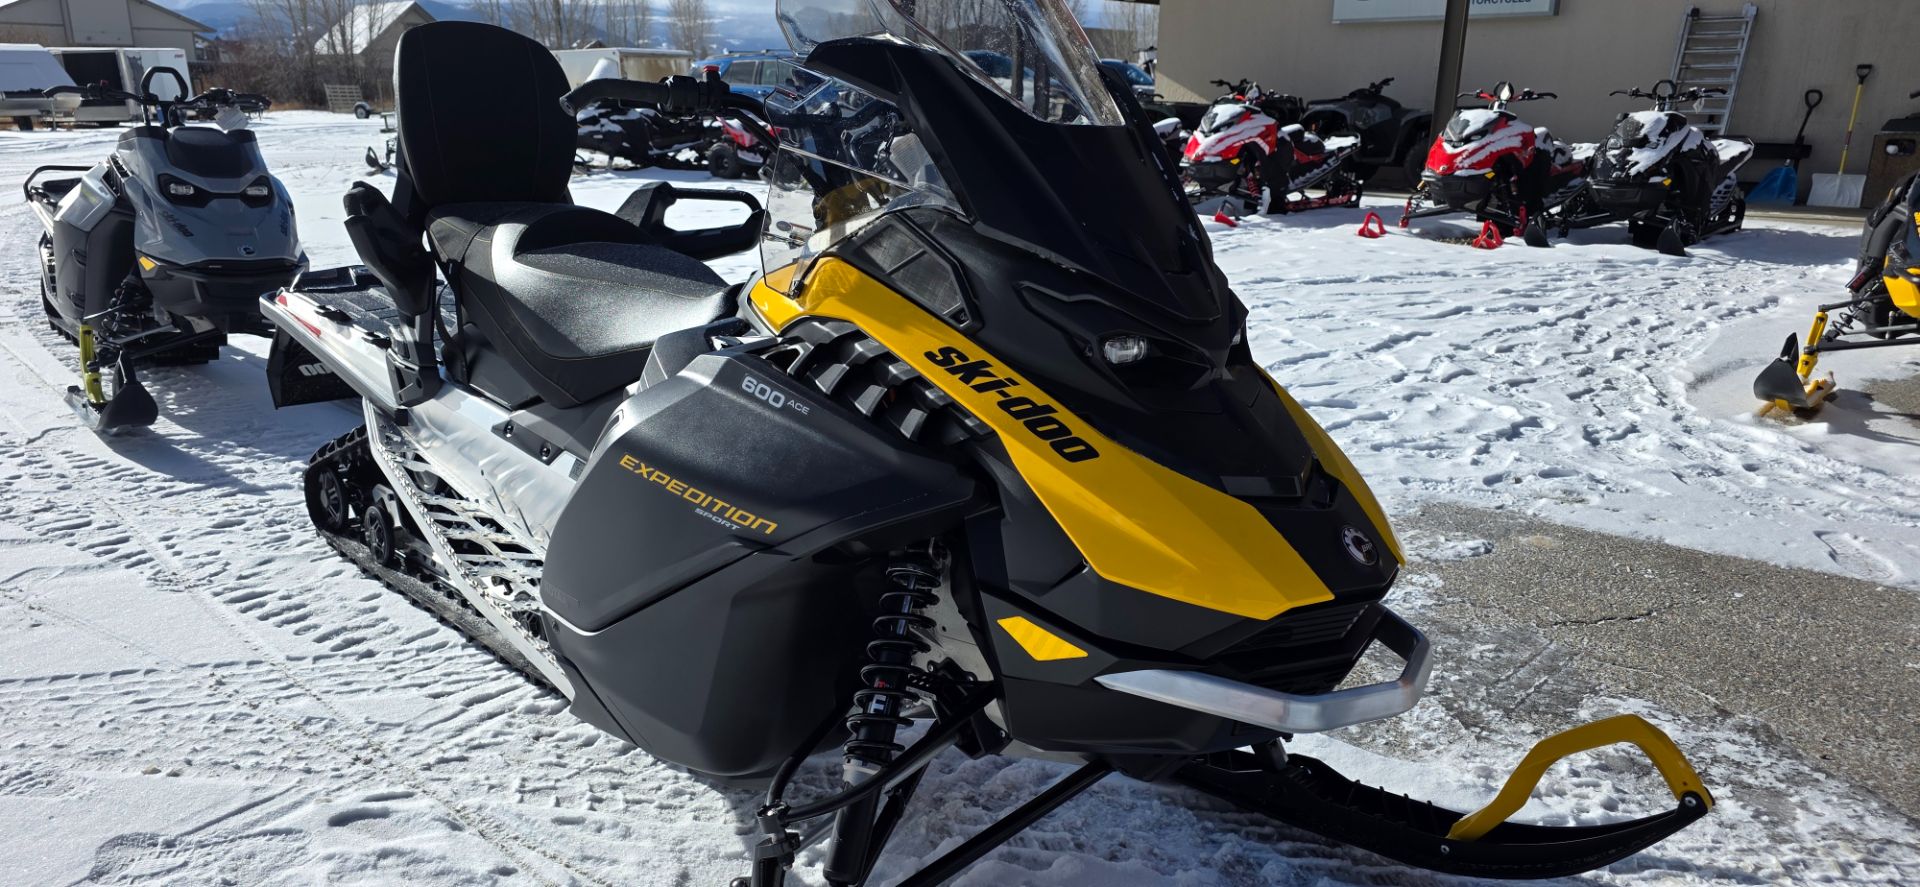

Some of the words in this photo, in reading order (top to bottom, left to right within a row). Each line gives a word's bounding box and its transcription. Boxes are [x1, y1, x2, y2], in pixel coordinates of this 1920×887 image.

[742, 376, 785, 409] 600
[787, 399, 810, 416] ACE
[924, 346, 1100, 463] ski-doo
[619, 454, 778, 535] EXPEDITION
[695, 508, 740, 531] SPORT
